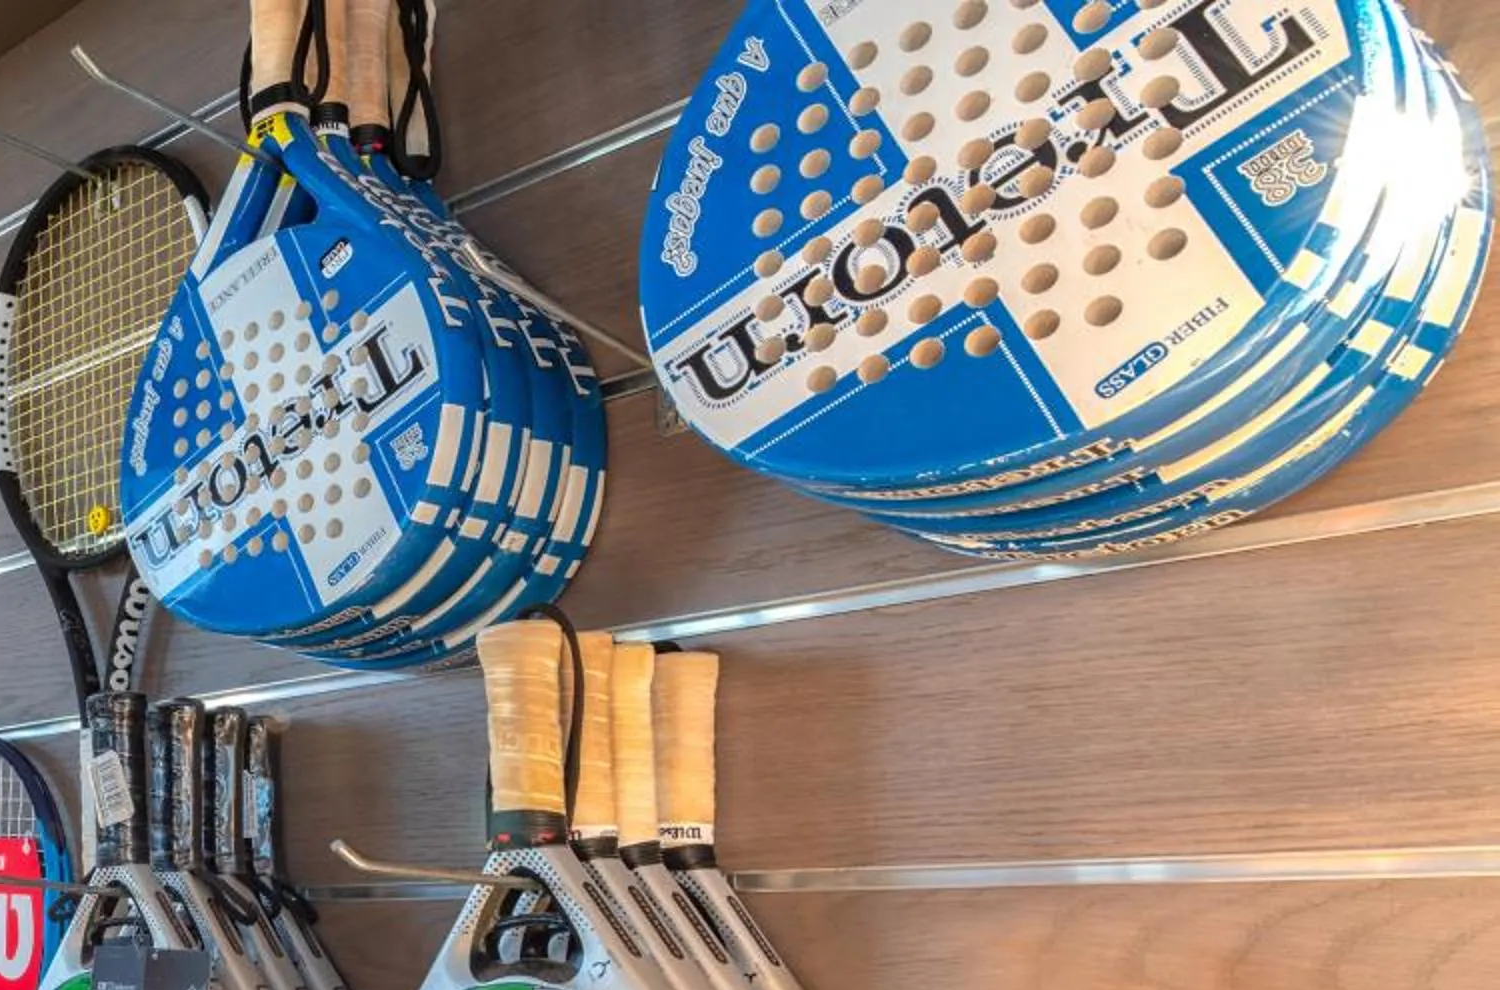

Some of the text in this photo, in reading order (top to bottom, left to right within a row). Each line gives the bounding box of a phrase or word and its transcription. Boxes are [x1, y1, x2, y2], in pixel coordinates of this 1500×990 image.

[737, 36, 770, 72] A
[706, 72, 747, 137] que
[672, 0, 1320, 410] Tretorn
[1097, 297, 1230, 397] FIBER GLASS
[131, 323, 426, 570] Tretorn
